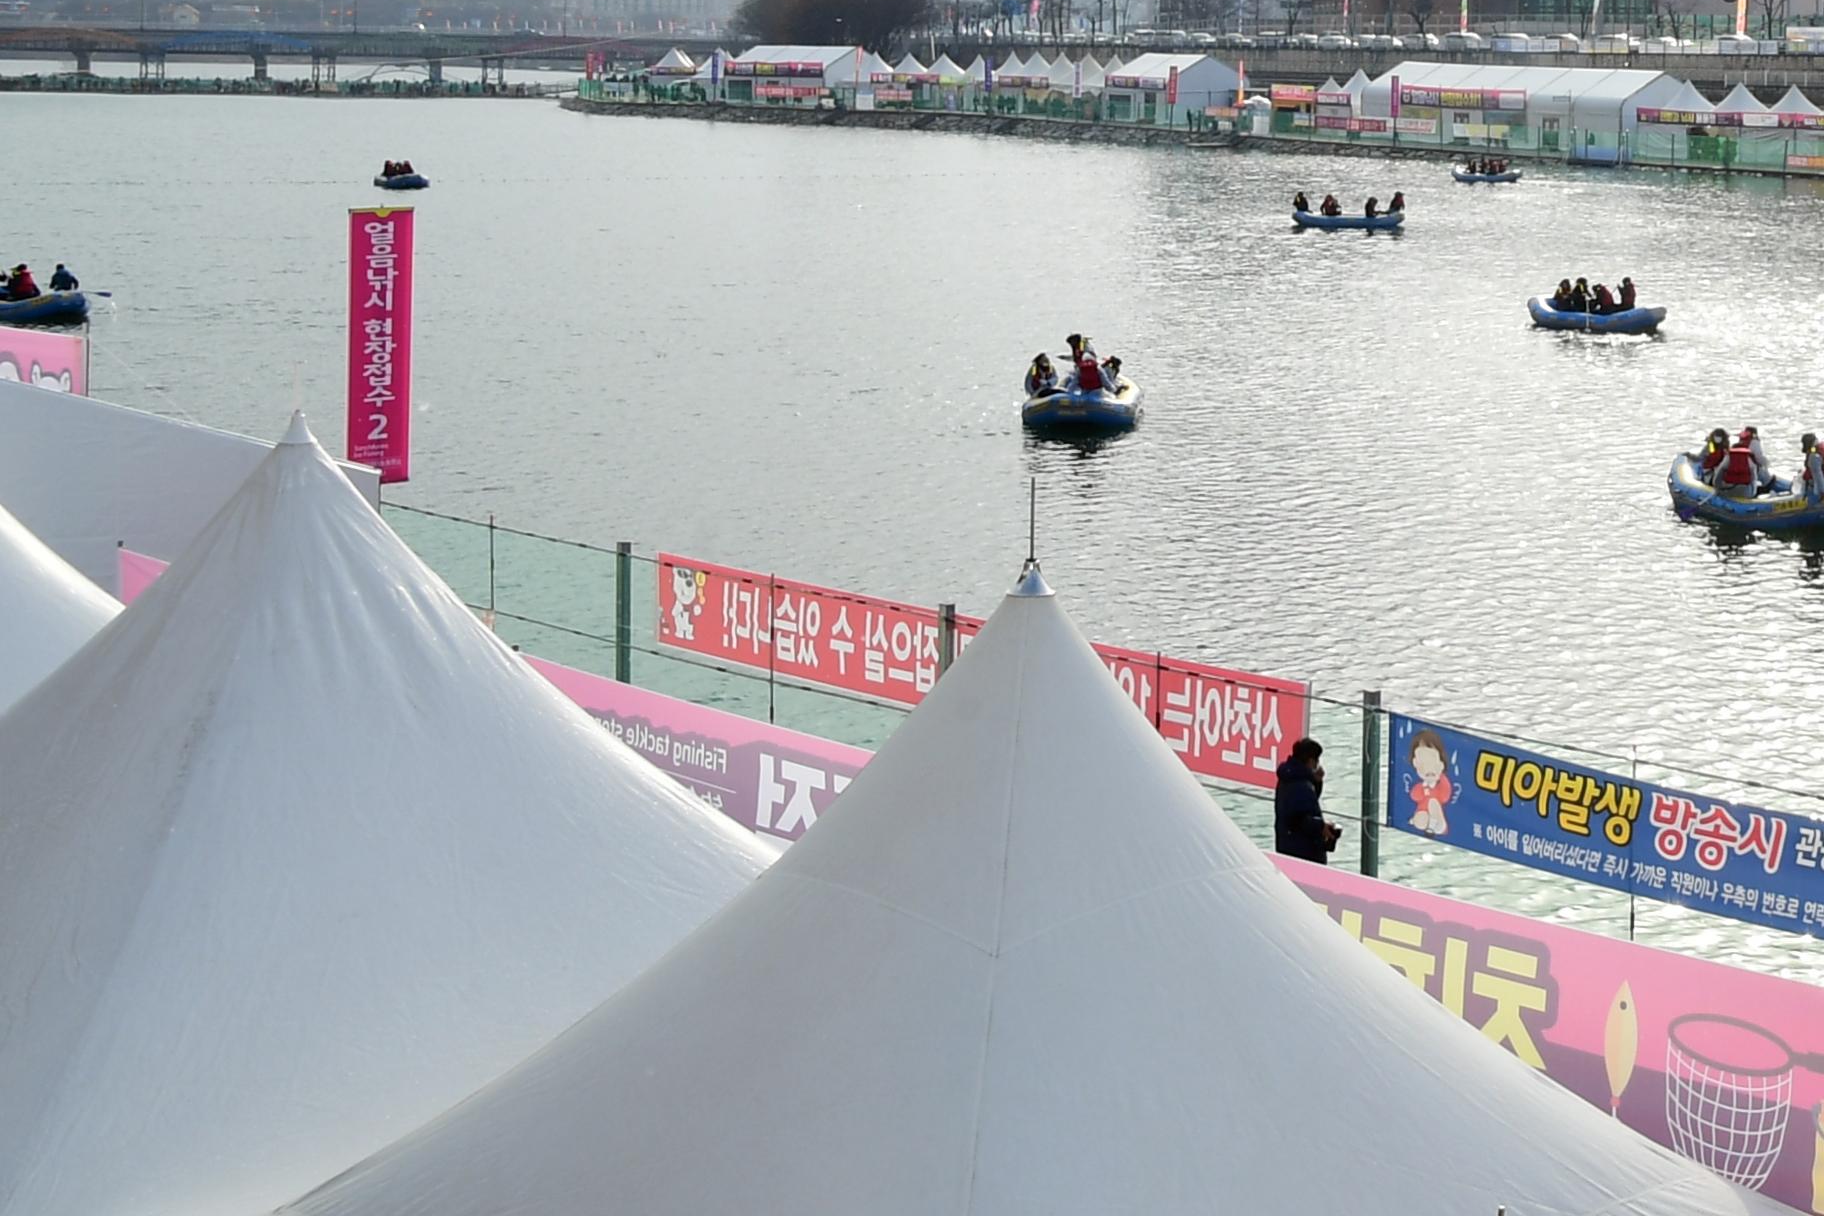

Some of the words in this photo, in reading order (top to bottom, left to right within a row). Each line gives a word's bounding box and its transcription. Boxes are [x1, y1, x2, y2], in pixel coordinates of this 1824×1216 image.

[363, 221, 399, 311] 얼음낚시
[362, 317, 397, 407] 현장접수
[367, 413, 388, 441] 2
[1474, 749, 1643, 847] 미아발생
[1648, 792, 1788, 875] 방송시
[1486, 827, 1520, 852] 아이를
[1603, 853, 1630, 880] 즉시
[1630, 861, 1667, 889] 가까운
[1670, 870, 1719, 901] 직원이나
[1720, 882, 1759, 911] 우측의
[1761, 891, 1800, 920] 번호로
